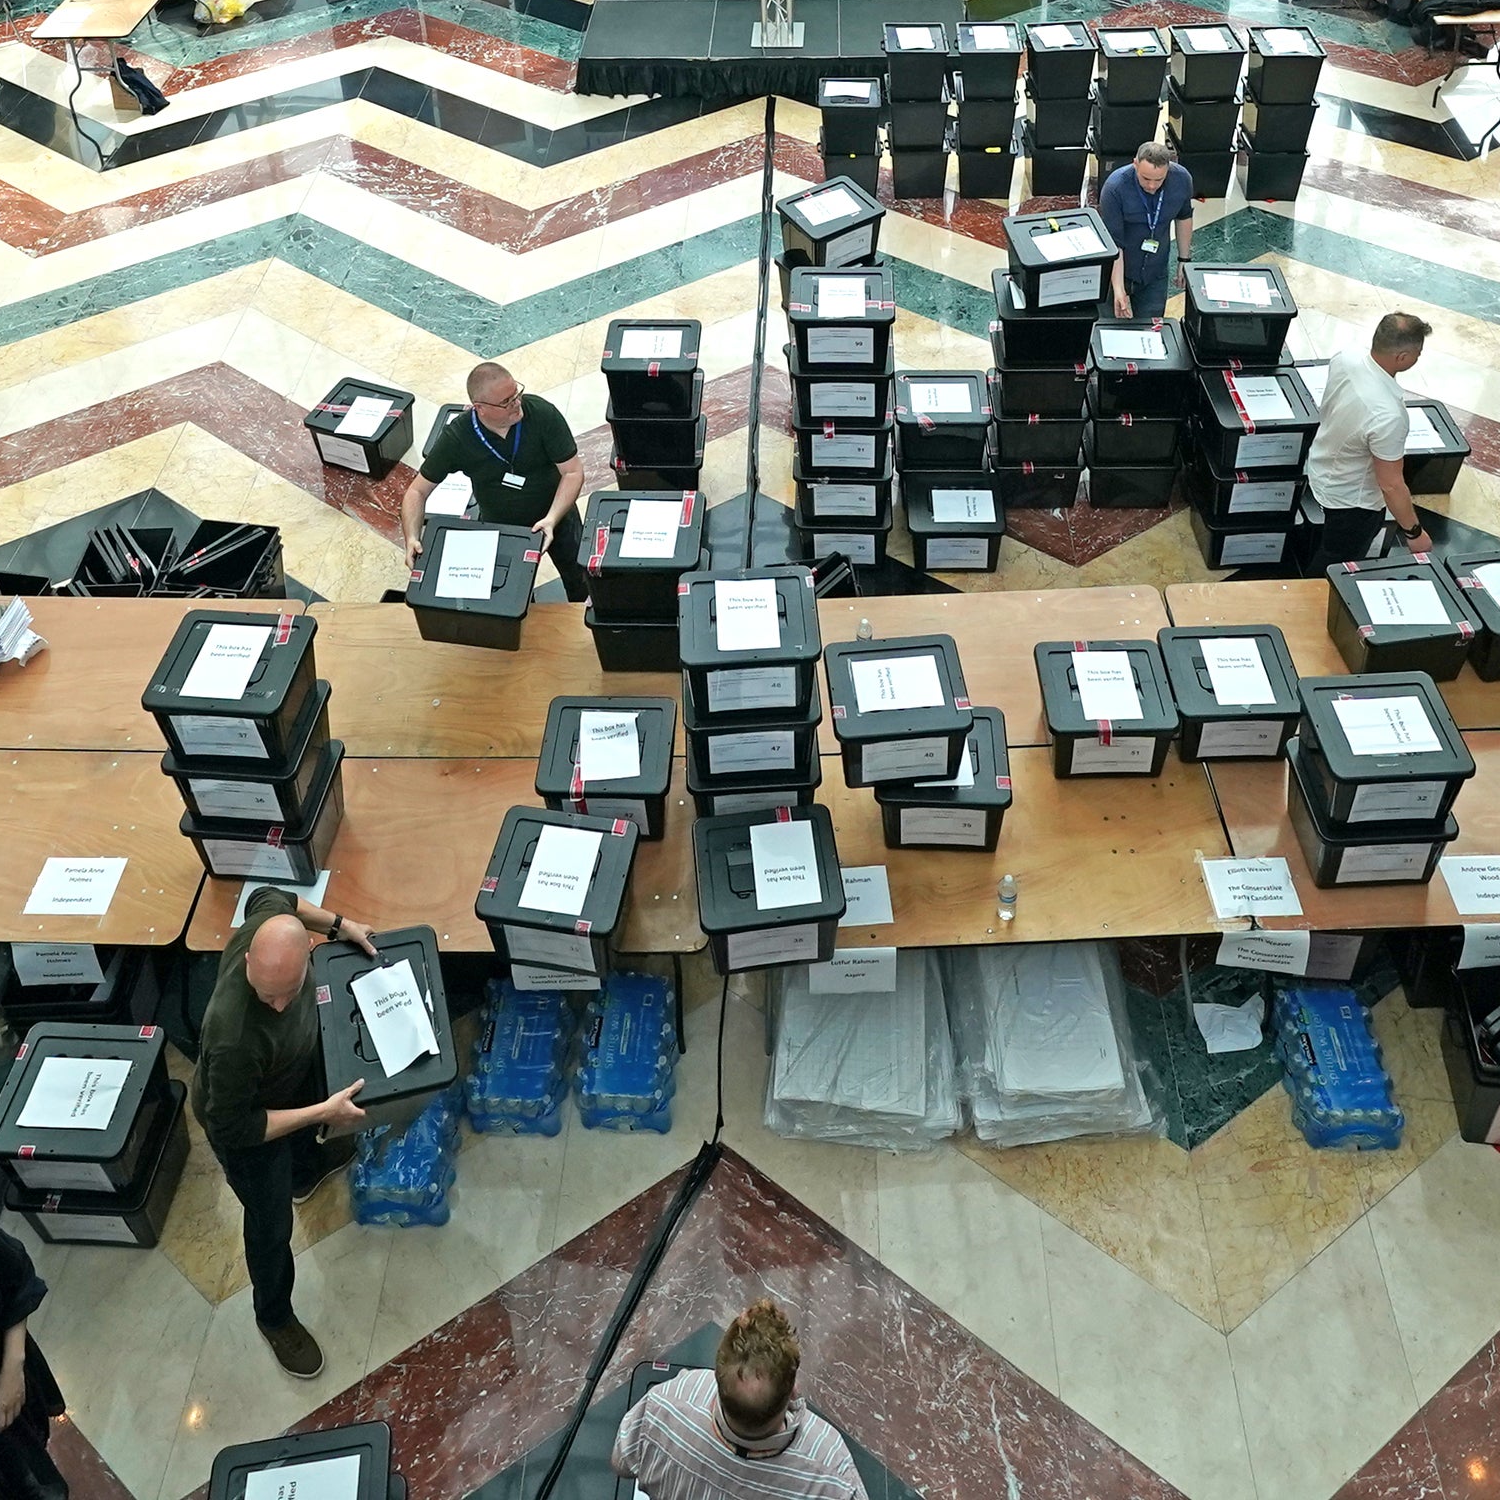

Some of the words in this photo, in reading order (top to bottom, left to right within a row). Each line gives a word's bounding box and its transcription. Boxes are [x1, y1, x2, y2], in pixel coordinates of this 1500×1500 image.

[607, 730, 629, 740] verified
[538, 870, 562, 878] verified
[1227, 867, 1246, 875] Elliott
[563, 873, 579, 881] been
[1233, 894, 1250, 902] Party
[1265, 939, 1292, 947] Weaver
[1251, 950, 1295, 959] Conservative
[374, 996, 388, 1007] This
[376, 1005, 394, 1018] been
[1323, 1051, 1341, 1086] spring
[83, 1071, 93, 1089] been
[93, 1074, 101, 1088] This
[87, 1088, 96, 1102] box
[70, 1091, 85, 1117] verified
[80, 1103, 90, 1116] has
